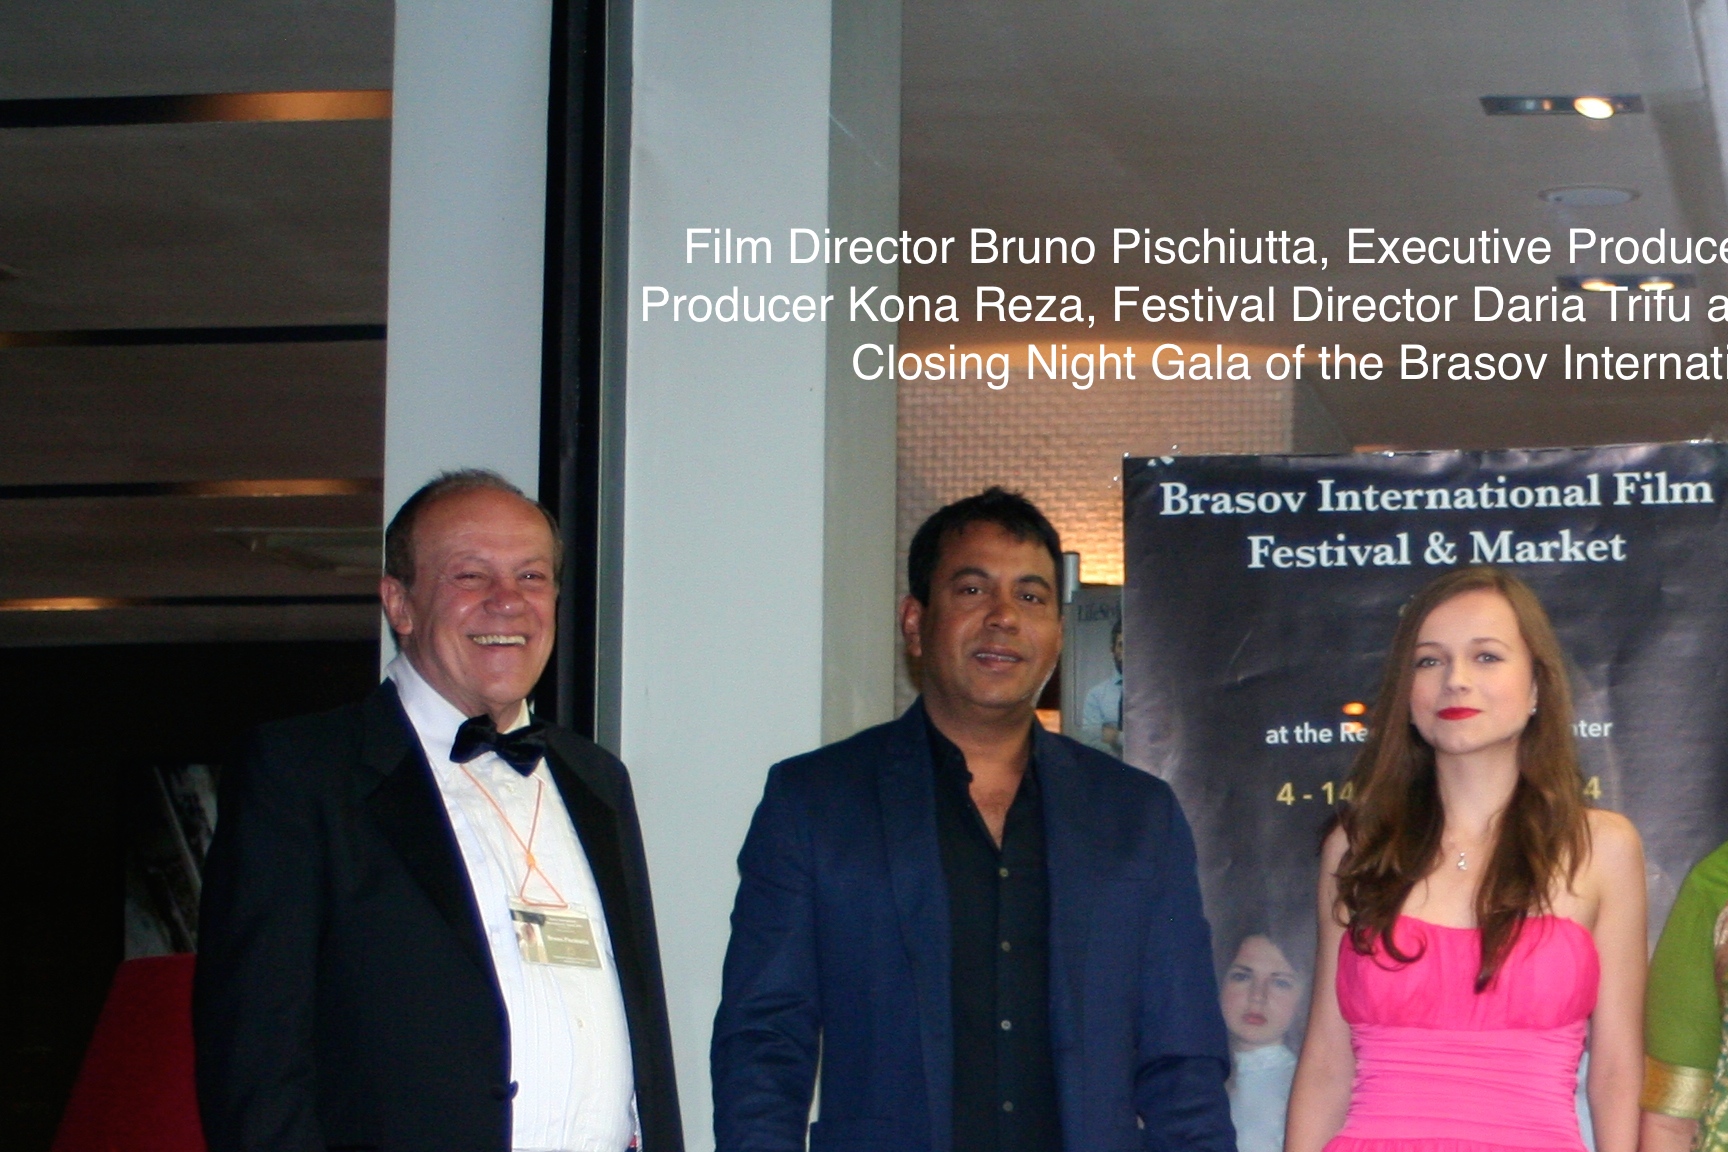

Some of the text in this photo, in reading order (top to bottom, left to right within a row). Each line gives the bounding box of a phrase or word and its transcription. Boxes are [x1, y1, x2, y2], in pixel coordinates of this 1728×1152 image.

[1160, 471, 1714, 516] Brasov International Film
[1247, 529, 1627, 568] Festival & Market
[1265, 725, 1290, 744] at
[1294, 722, 1333, 743] the
[1276, 781, 1296, 806] 4
